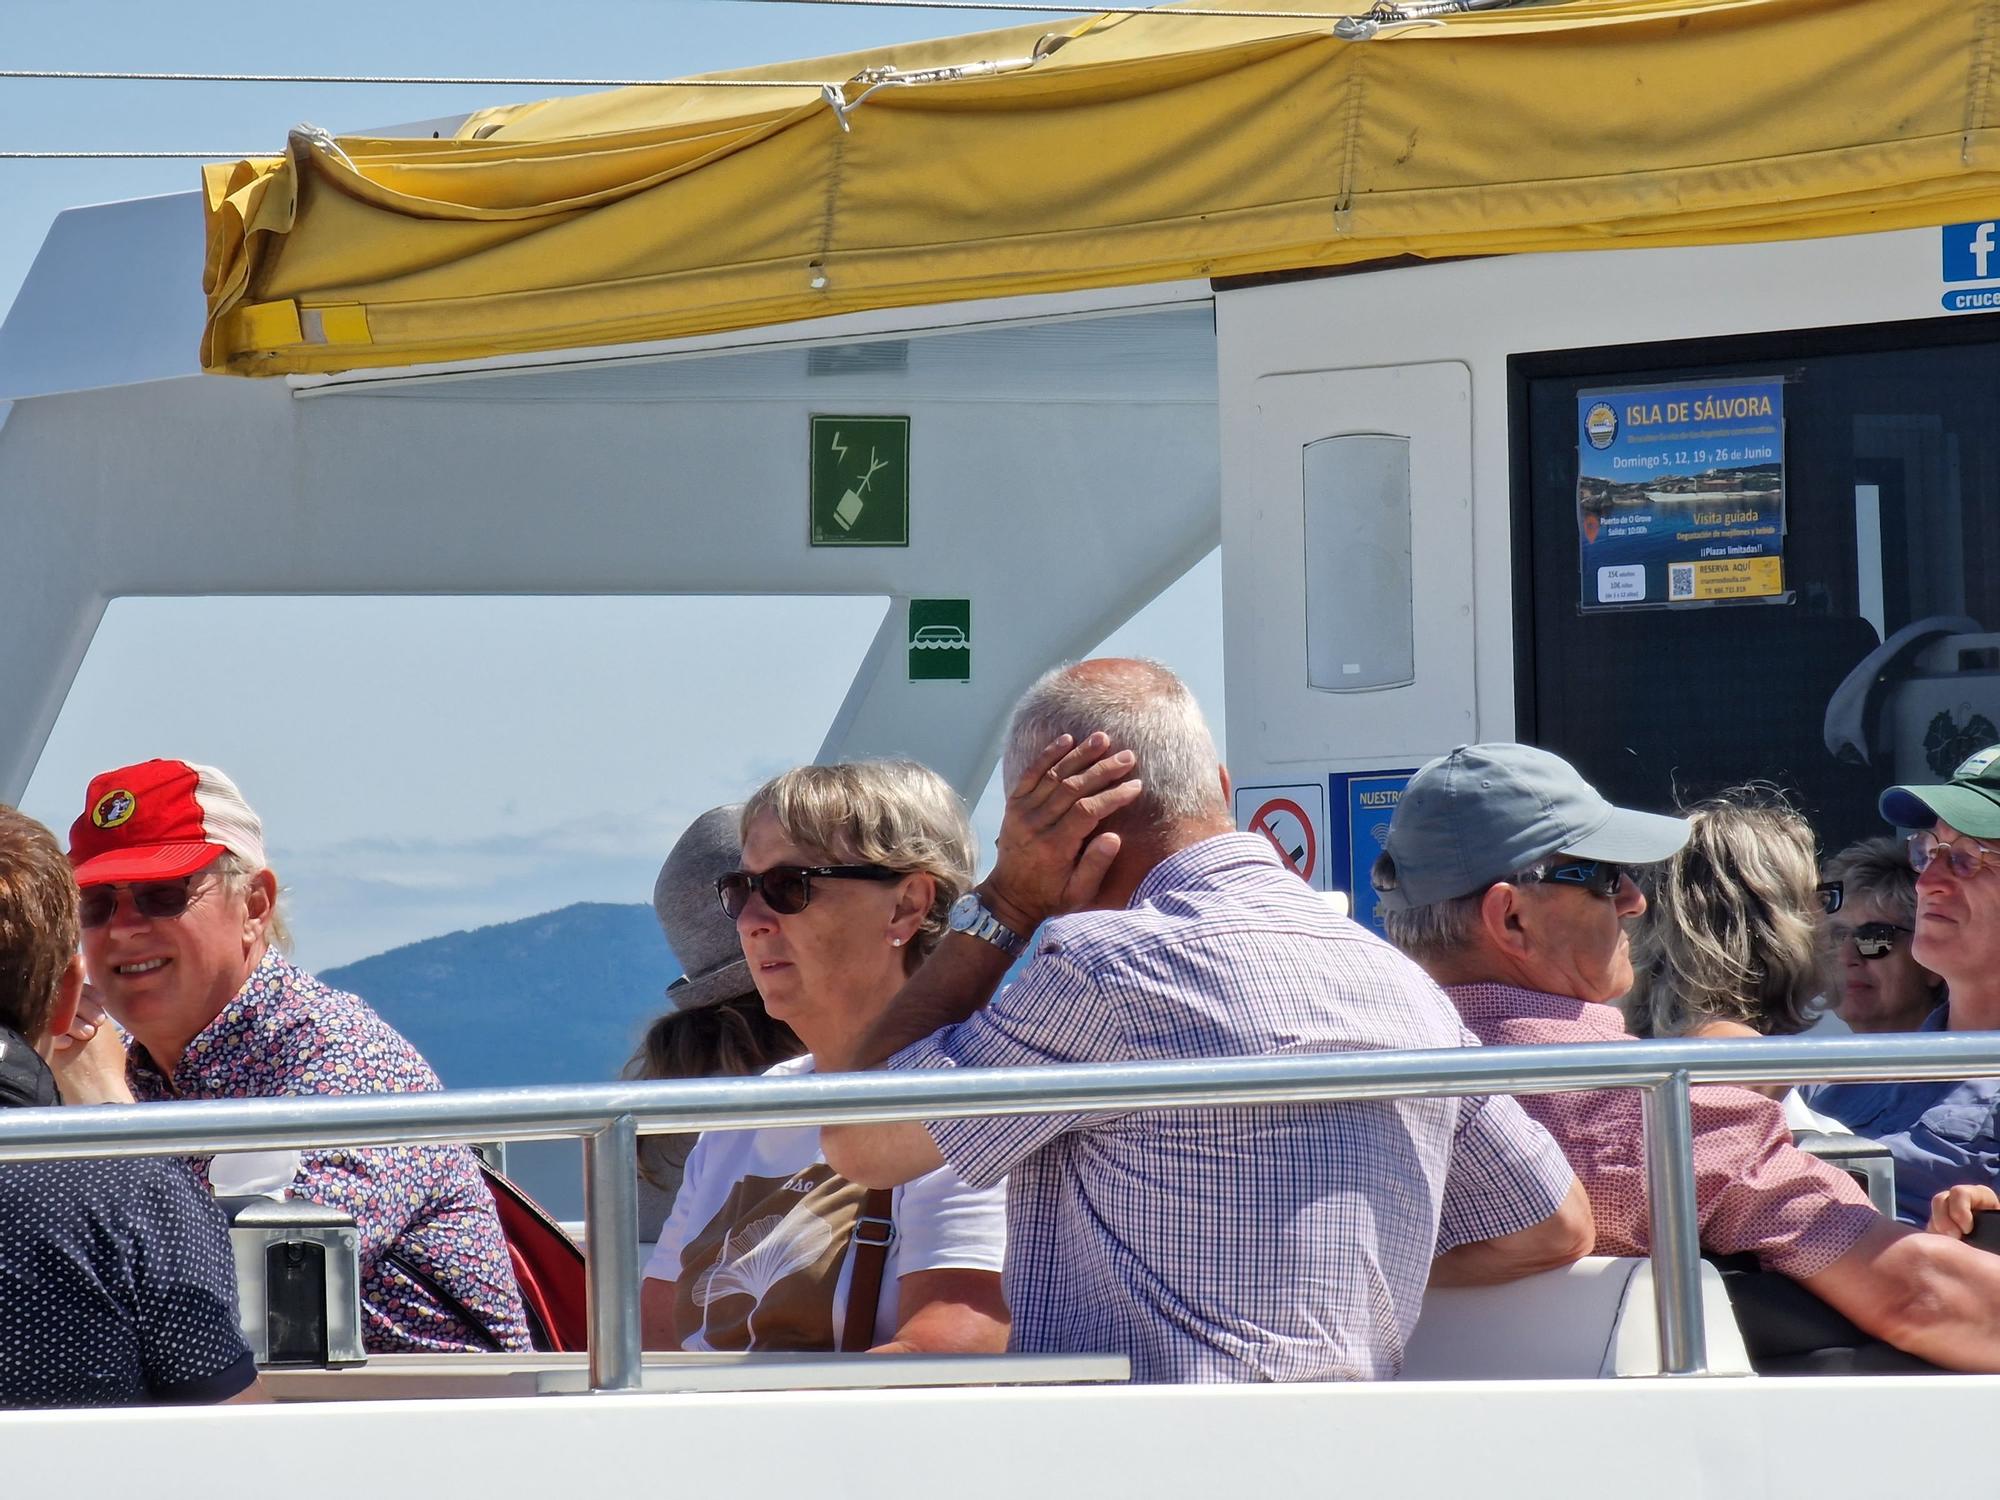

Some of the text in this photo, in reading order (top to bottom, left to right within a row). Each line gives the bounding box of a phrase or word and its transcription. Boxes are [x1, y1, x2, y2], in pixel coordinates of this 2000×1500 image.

[1626, 404, 1662, 426] ISLA
[1667, 402, 1689, 423] DE
[1693, 394, 1772, 421] SÁLVORA
[1613, 445, 1772, 470] Domingo 5, 12, 19 y 26 de Junio
[1694, 509, 1759, 526] Visita guiada
[1699, 560, 1751, 573] RESERVA AQUÍ
